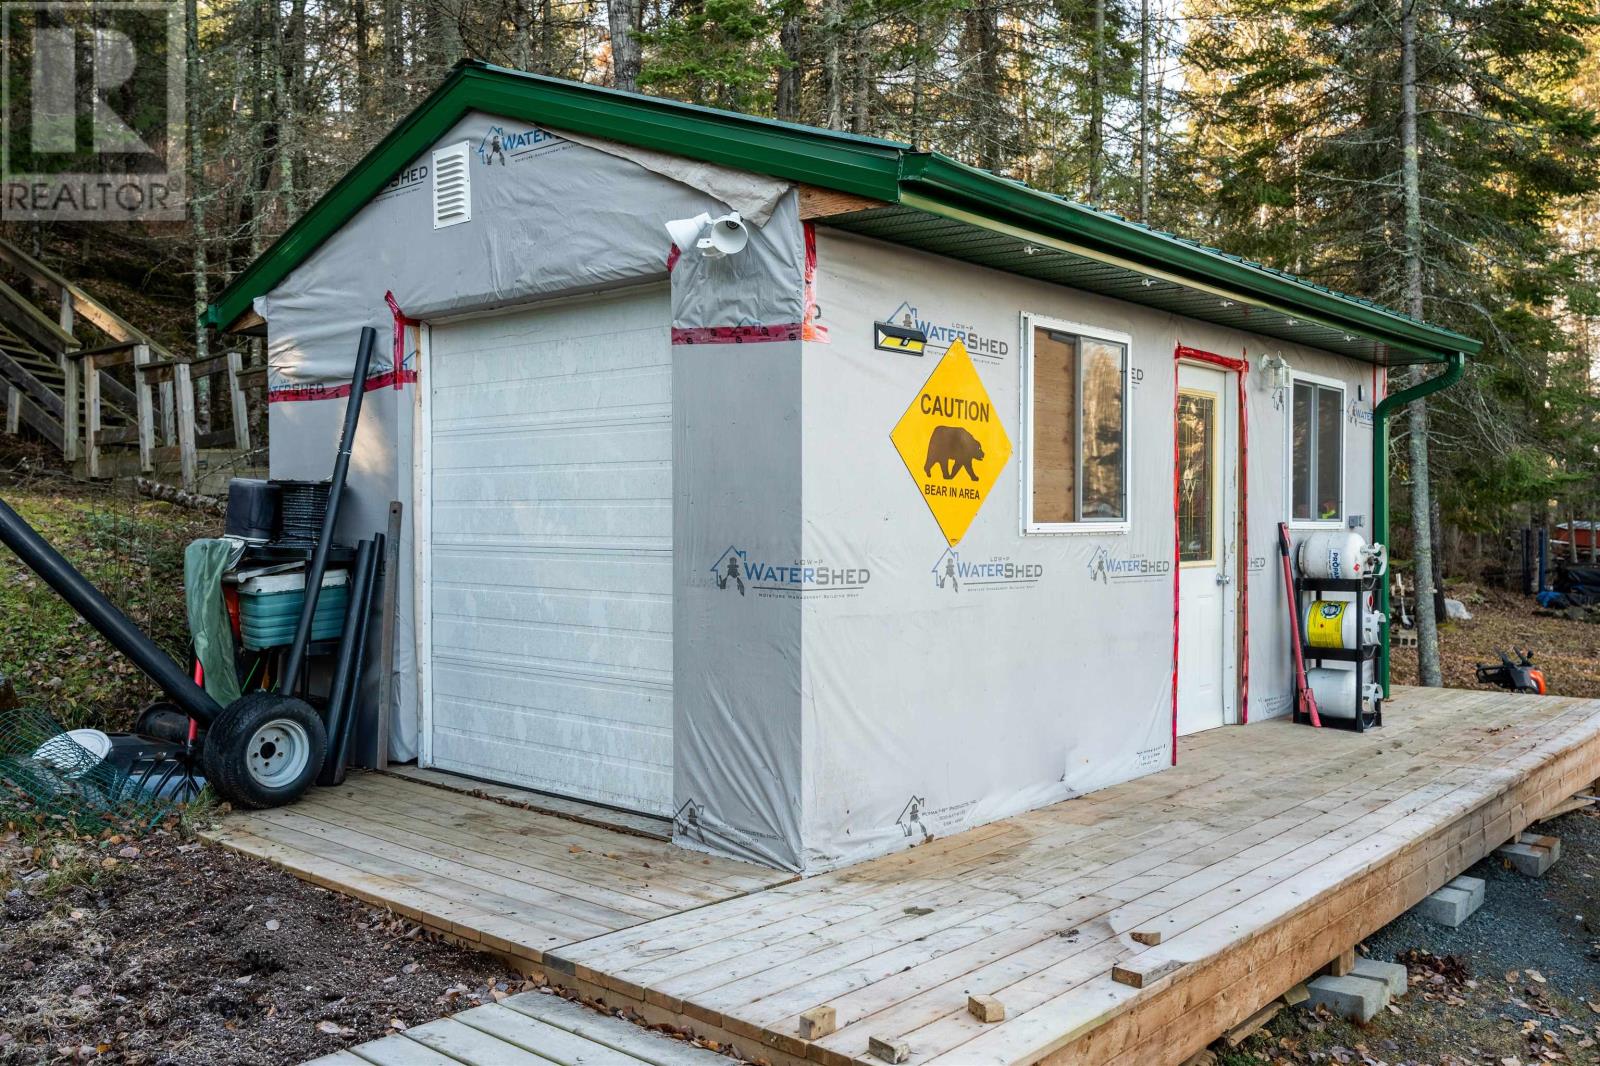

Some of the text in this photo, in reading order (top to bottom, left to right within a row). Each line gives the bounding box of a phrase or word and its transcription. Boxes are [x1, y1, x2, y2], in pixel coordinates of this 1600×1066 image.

[502, 128, 561, 151] WATER
[921, 393, 990, 422] CAUTION
[924, 484, 981, 500] BEAR IN AREA
[744, 562, 871, 586] WATERSHED
[957, 562, 1043, 579] WATERSHED
[1106, 558, 1170, 573] WATERSHED
